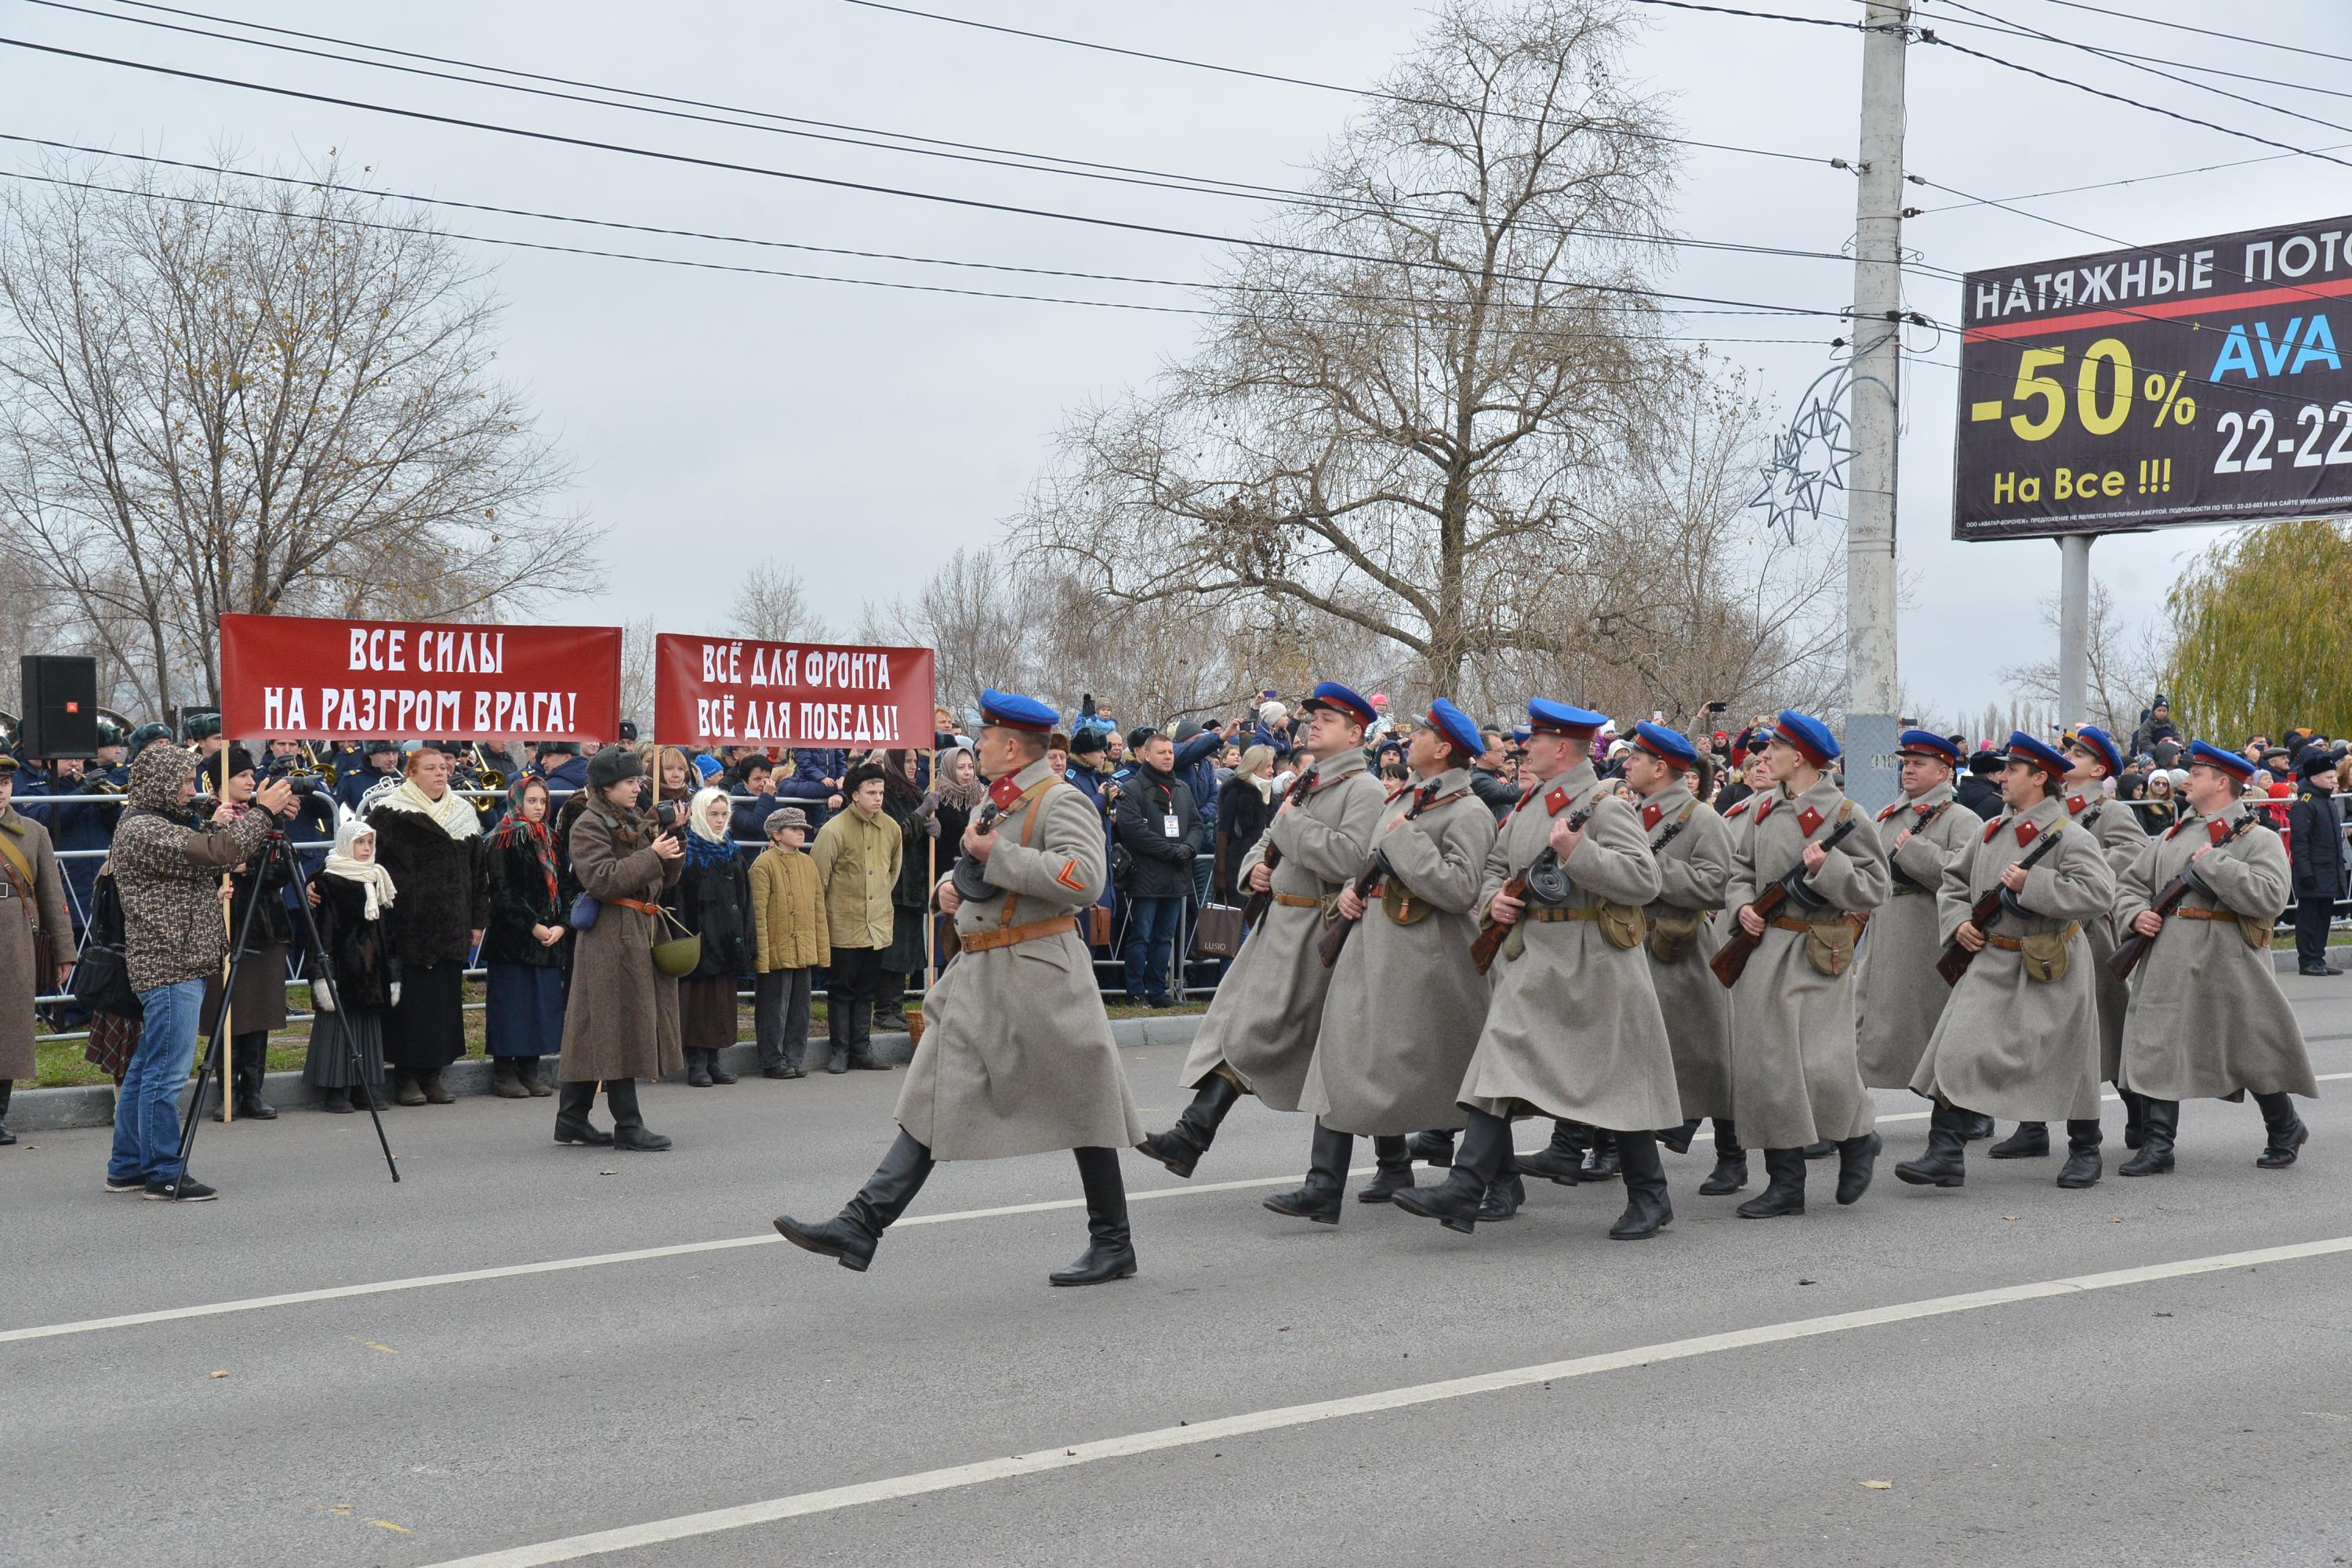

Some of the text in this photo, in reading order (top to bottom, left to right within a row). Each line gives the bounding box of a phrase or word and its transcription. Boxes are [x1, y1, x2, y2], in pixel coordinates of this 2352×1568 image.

[1976, 230, 2352, 319] НАТЯЖНЫЕ ПОТ
[2209, 314, 2342, 383] AVA
[1994, 459, 2171, 504] На Все !!!
[2031, 515, 2070, 524] ПРЕДЛОЖЕНИЕ
[2078, 512, 2107, 521] ЯВЛЯЕТСЯ
[2169, 505, 2211, 514] ПОДРОБНОСТИ
[2278, 498, 2298, 506] САЙТЕ
[348, 628, 504, 673] ВСЕ СИЛЫ
[702, 641, 891, 690] ВСЁ ДЛЯ ФРОНТА
[263, 687, 577, 733] НА РАЗГРОМ ВРАГА!
[697, 695, 899, 744] ВСЁ ДЛЯ ПОБЕДЫ!
[1204, 942, 1226, 951] LUSIO
